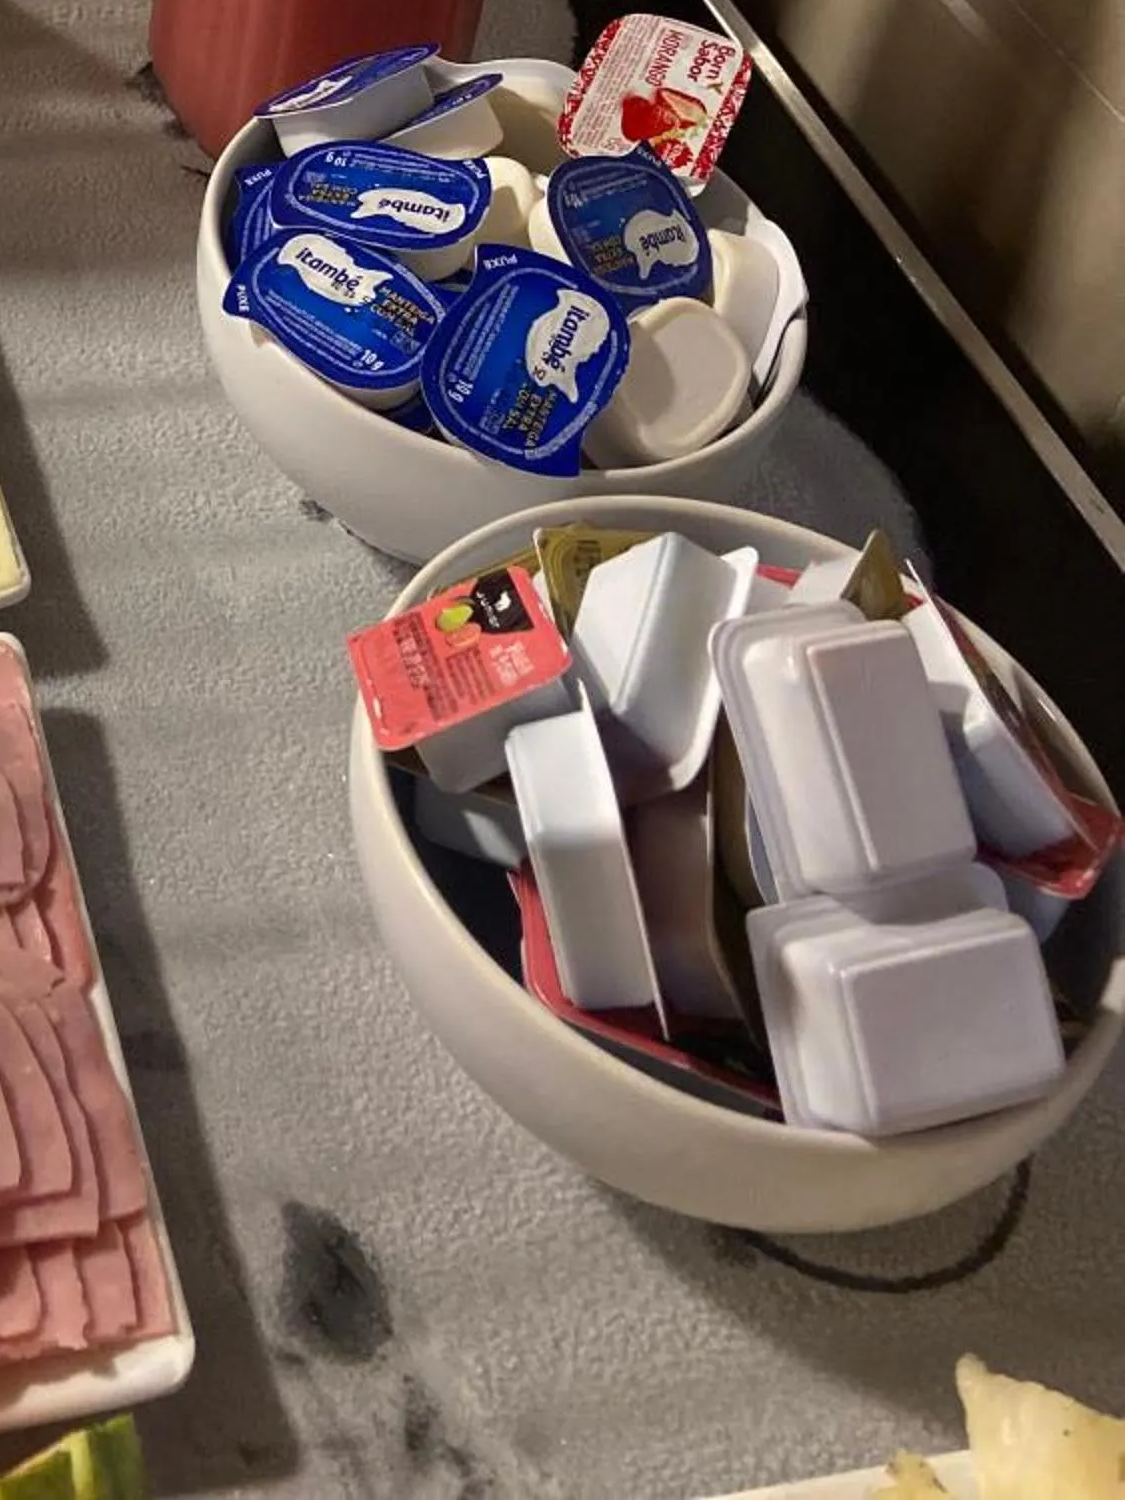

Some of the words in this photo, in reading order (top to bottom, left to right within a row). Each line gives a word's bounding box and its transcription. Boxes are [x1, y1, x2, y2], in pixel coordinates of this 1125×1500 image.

[644, 29, 684, 87] MORANGO
[688, 39, 710, 82] Sabor
[378, 198, 451, 223] itambé
[295, 246, 363, 292] itambé
[547, 305, 591, 373] itambé
